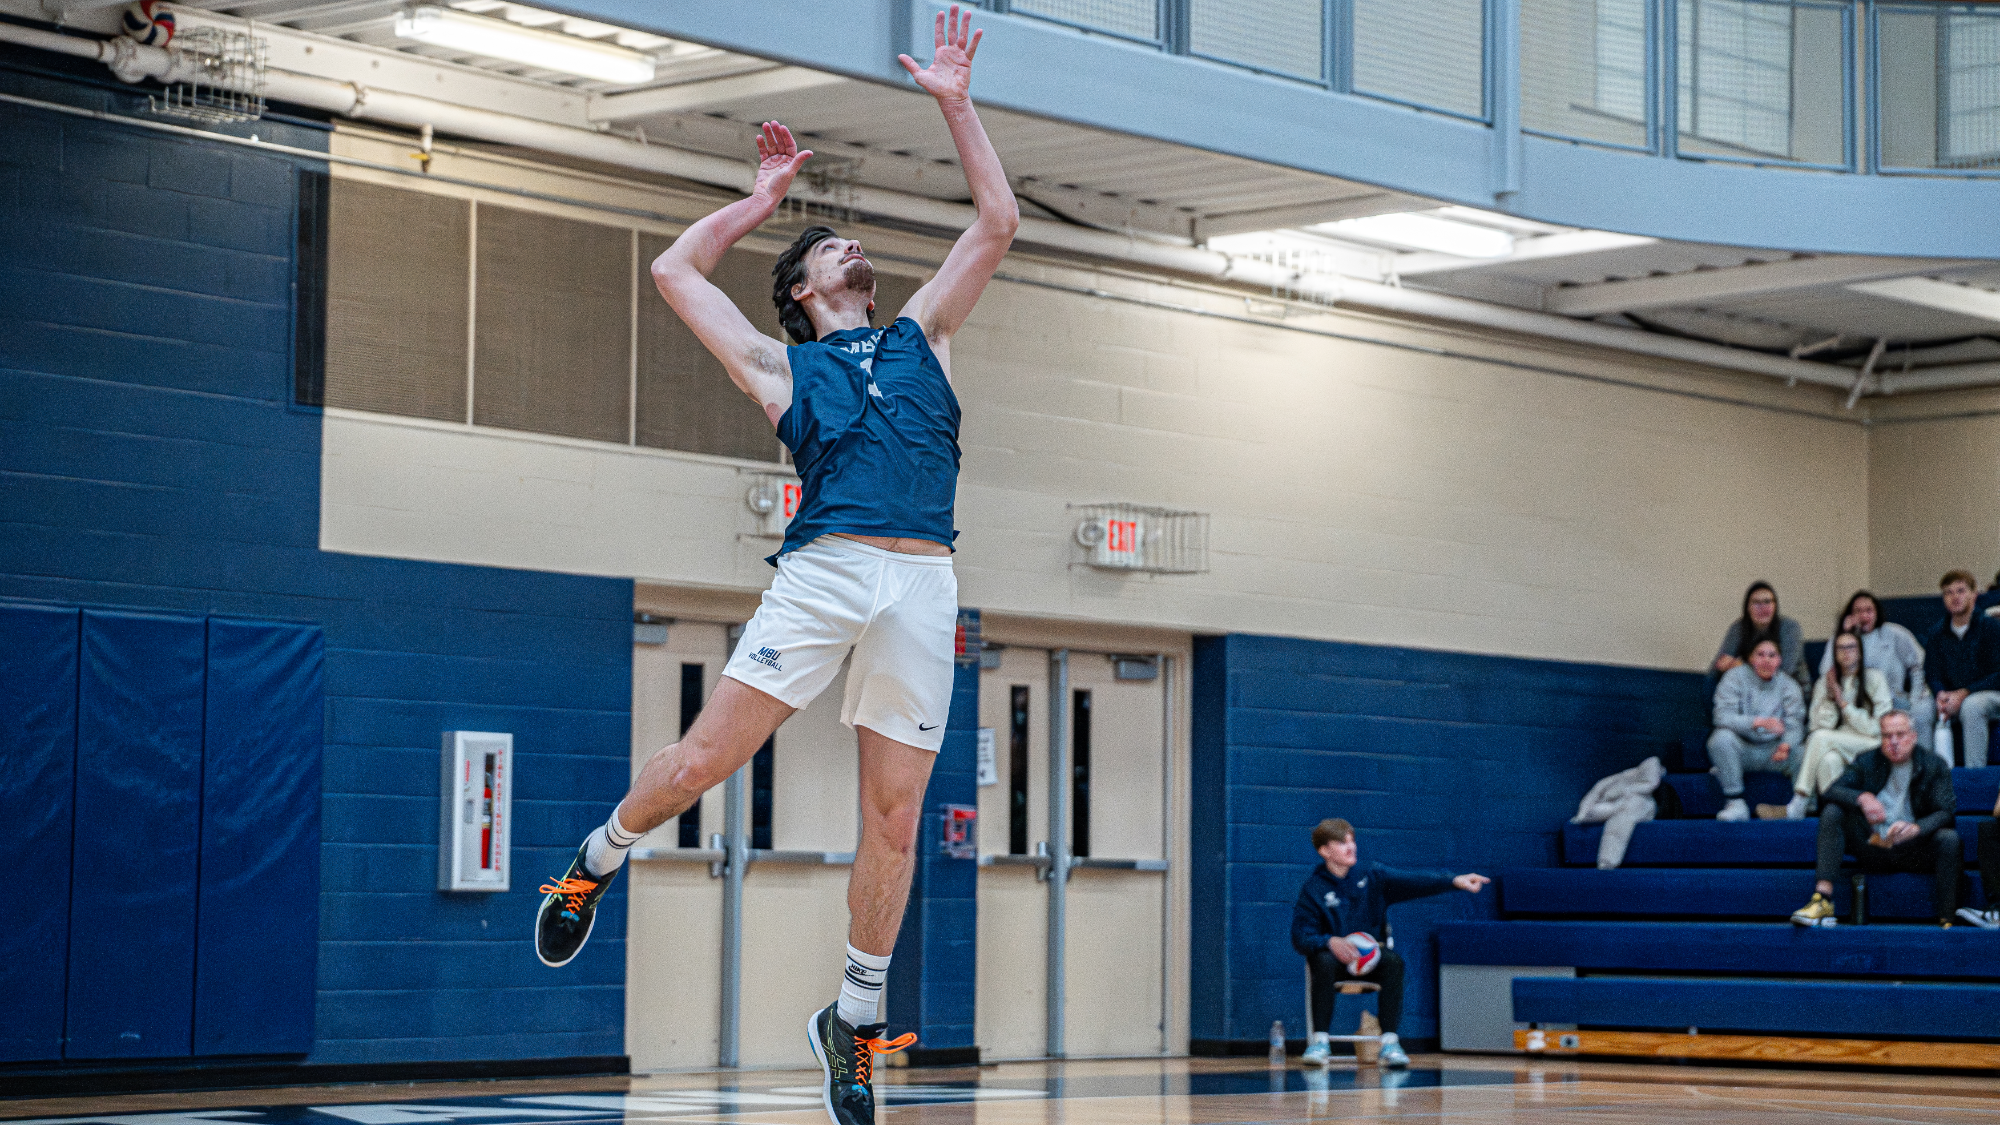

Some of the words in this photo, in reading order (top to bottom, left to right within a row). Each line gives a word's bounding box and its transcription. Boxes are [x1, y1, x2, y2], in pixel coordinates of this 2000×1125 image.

[1107, 519, 1137, 553] EXIT
[748, 652, 782, 671] VOLLEYBALL
[757, 646, 782, 661] MBU
[851, 963, 867, 975] NIKE
